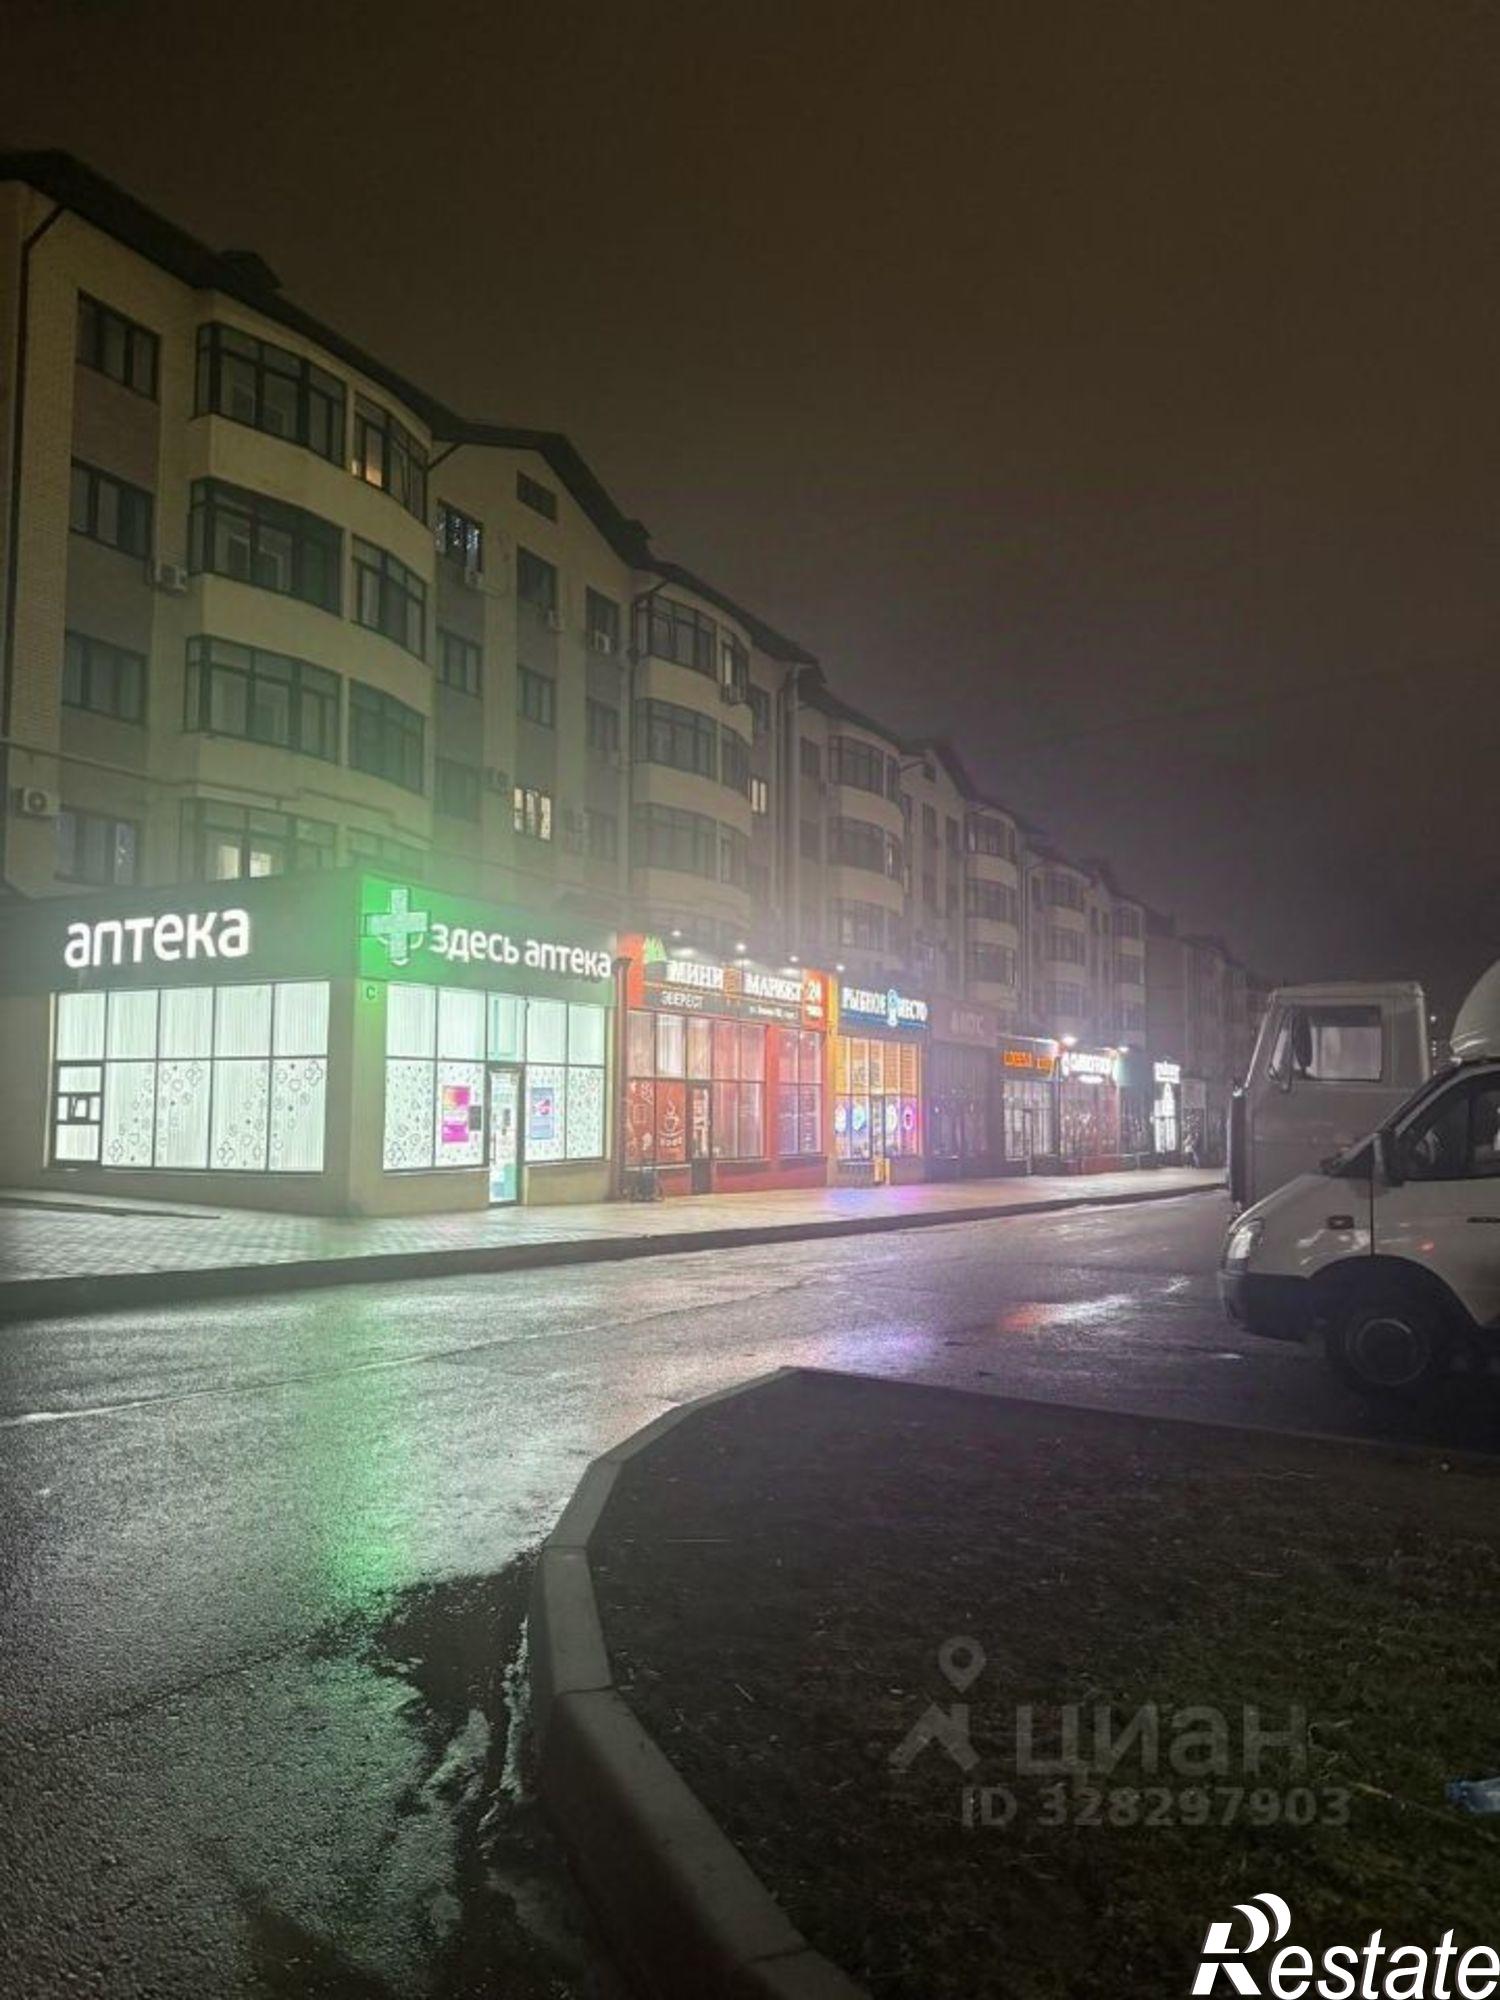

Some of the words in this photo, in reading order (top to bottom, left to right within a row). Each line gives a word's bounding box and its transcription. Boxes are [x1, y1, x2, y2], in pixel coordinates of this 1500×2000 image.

[64, 908, 250, 968] аптека
[430, 923, 519, 964] здесь
[524, 940, 612, 978] аптека
